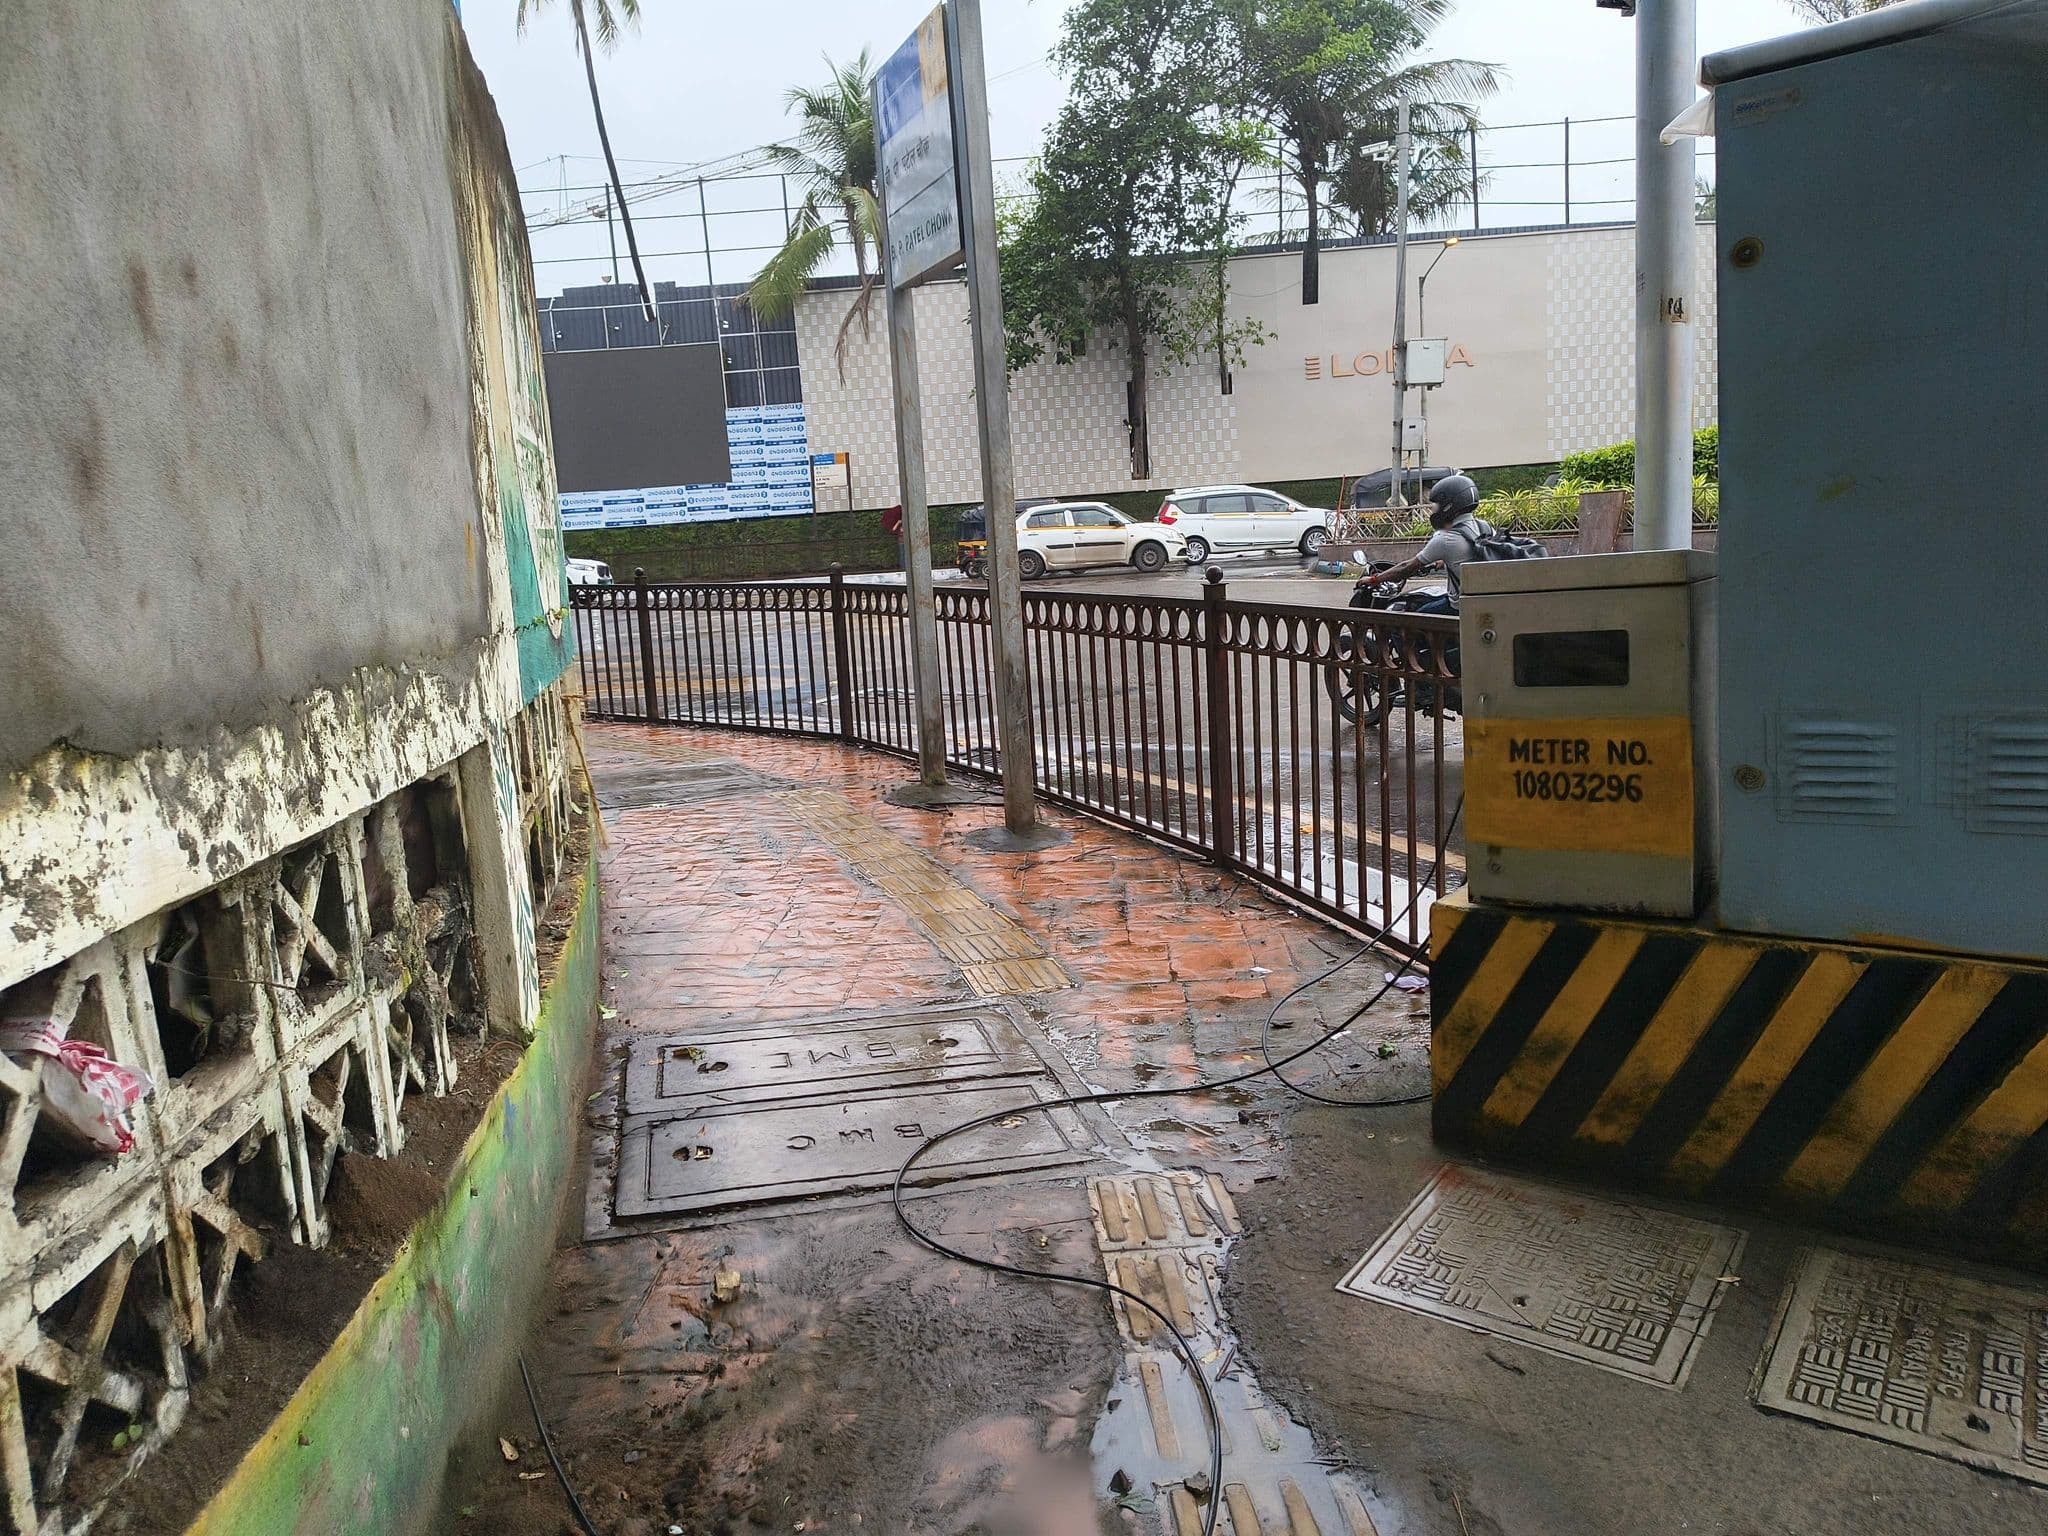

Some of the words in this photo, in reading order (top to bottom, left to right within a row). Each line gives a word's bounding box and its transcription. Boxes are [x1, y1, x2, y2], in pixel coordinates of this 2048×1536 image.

[905, 226, 924, 252] PATEL
[926, 208, 953, 236] CHOWK
[1509, 738, 1591, 765] METER
[1607, 740, 1654, 765] NO.
[1513, 771, 1644, 803] 10803296
[1901, 1324, 1935, 1380] SIGNAL
[1936, 1329, 1971, 1399] TRAFFIC
